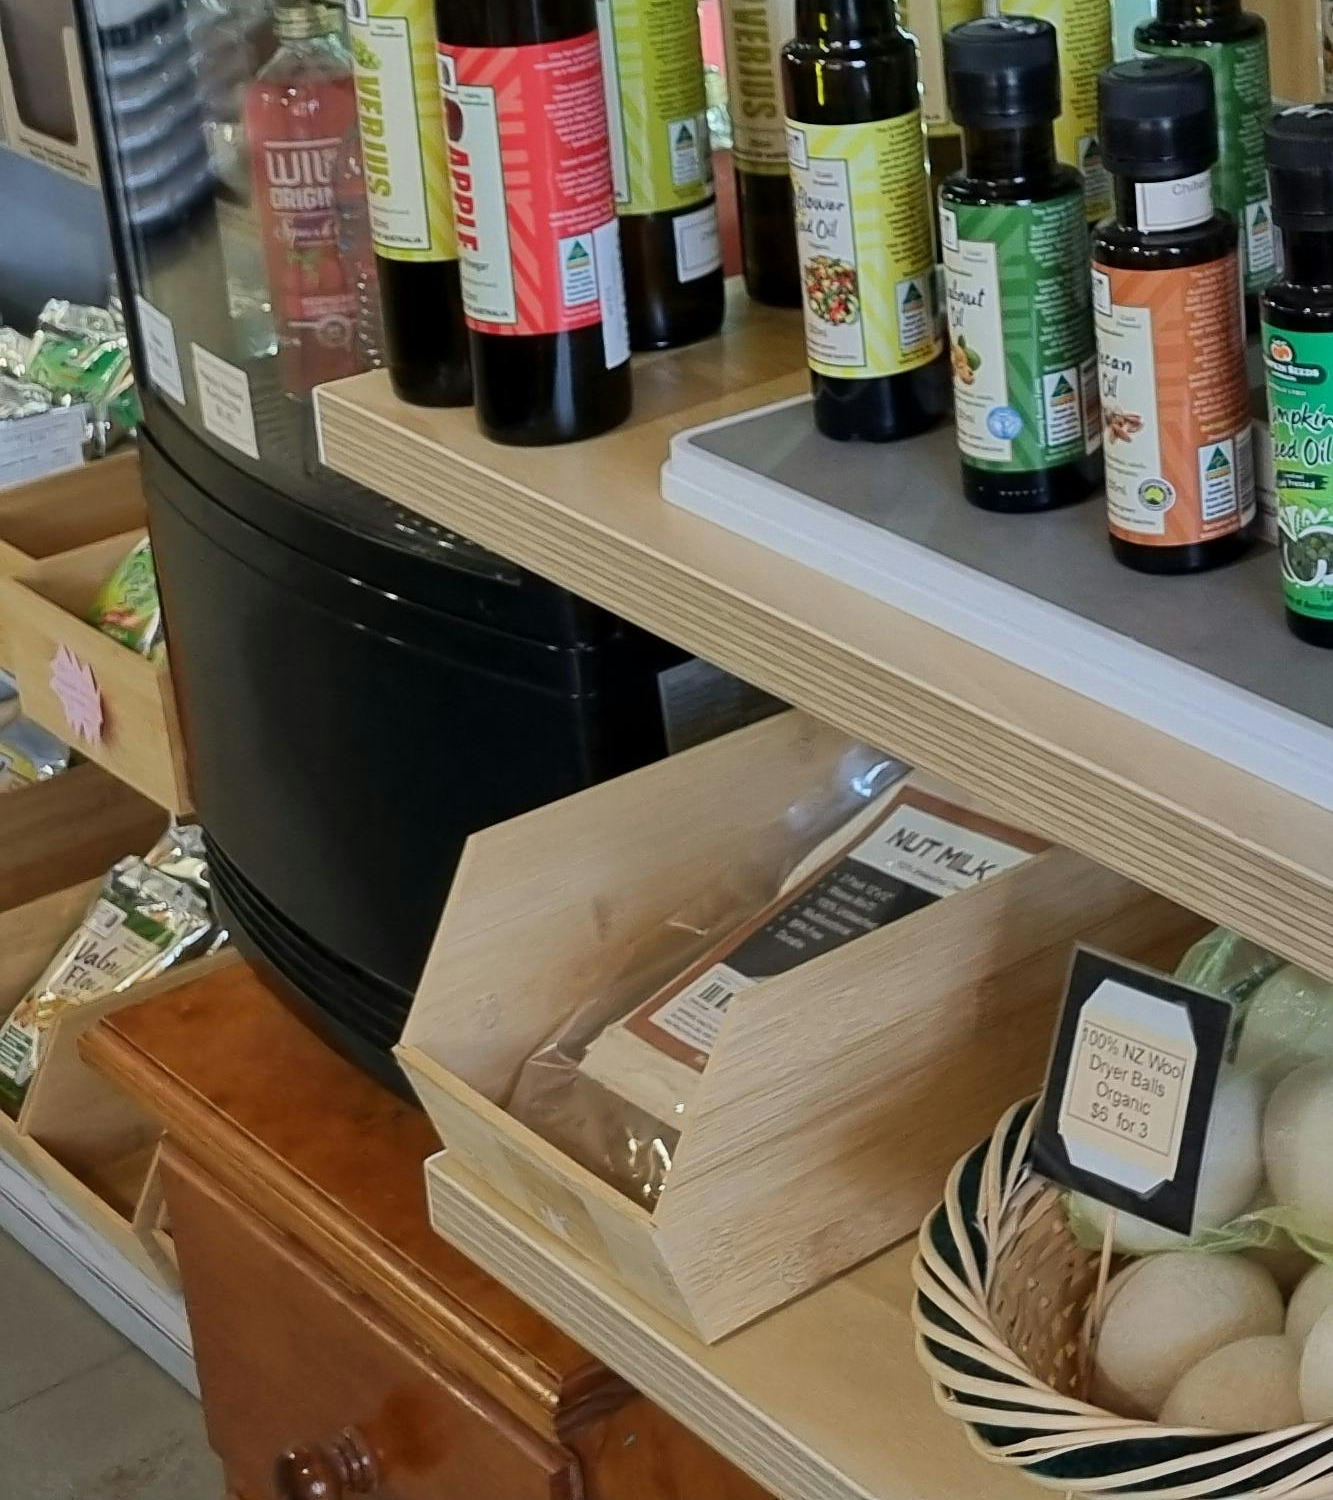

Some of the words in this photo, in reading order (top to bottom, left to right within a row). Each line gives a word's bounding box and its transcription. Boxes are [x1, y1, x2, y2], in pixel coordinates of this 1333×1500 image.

[1303, 436, 1333, 468] Oil
[884, 826, 944, 859] NUT
[933, 845, 1000, 884] MILK
[1080, 1025, 1120, 1057] 100%
[1122, 1043, 1145, 1067] NZ
[1146, 1052, 1187, 1082] Wool
[1088, 1053, 1129, 1085] Dryer
[1130, 1069, 1166, 1098] Balls
[1095, 1080, 1152, 1116] Organic
[1090, 1101, 1109, 1123] $6
[1115, 1111, 1138, 1133] for
[1138, 1120, 1149, 1139] 3
